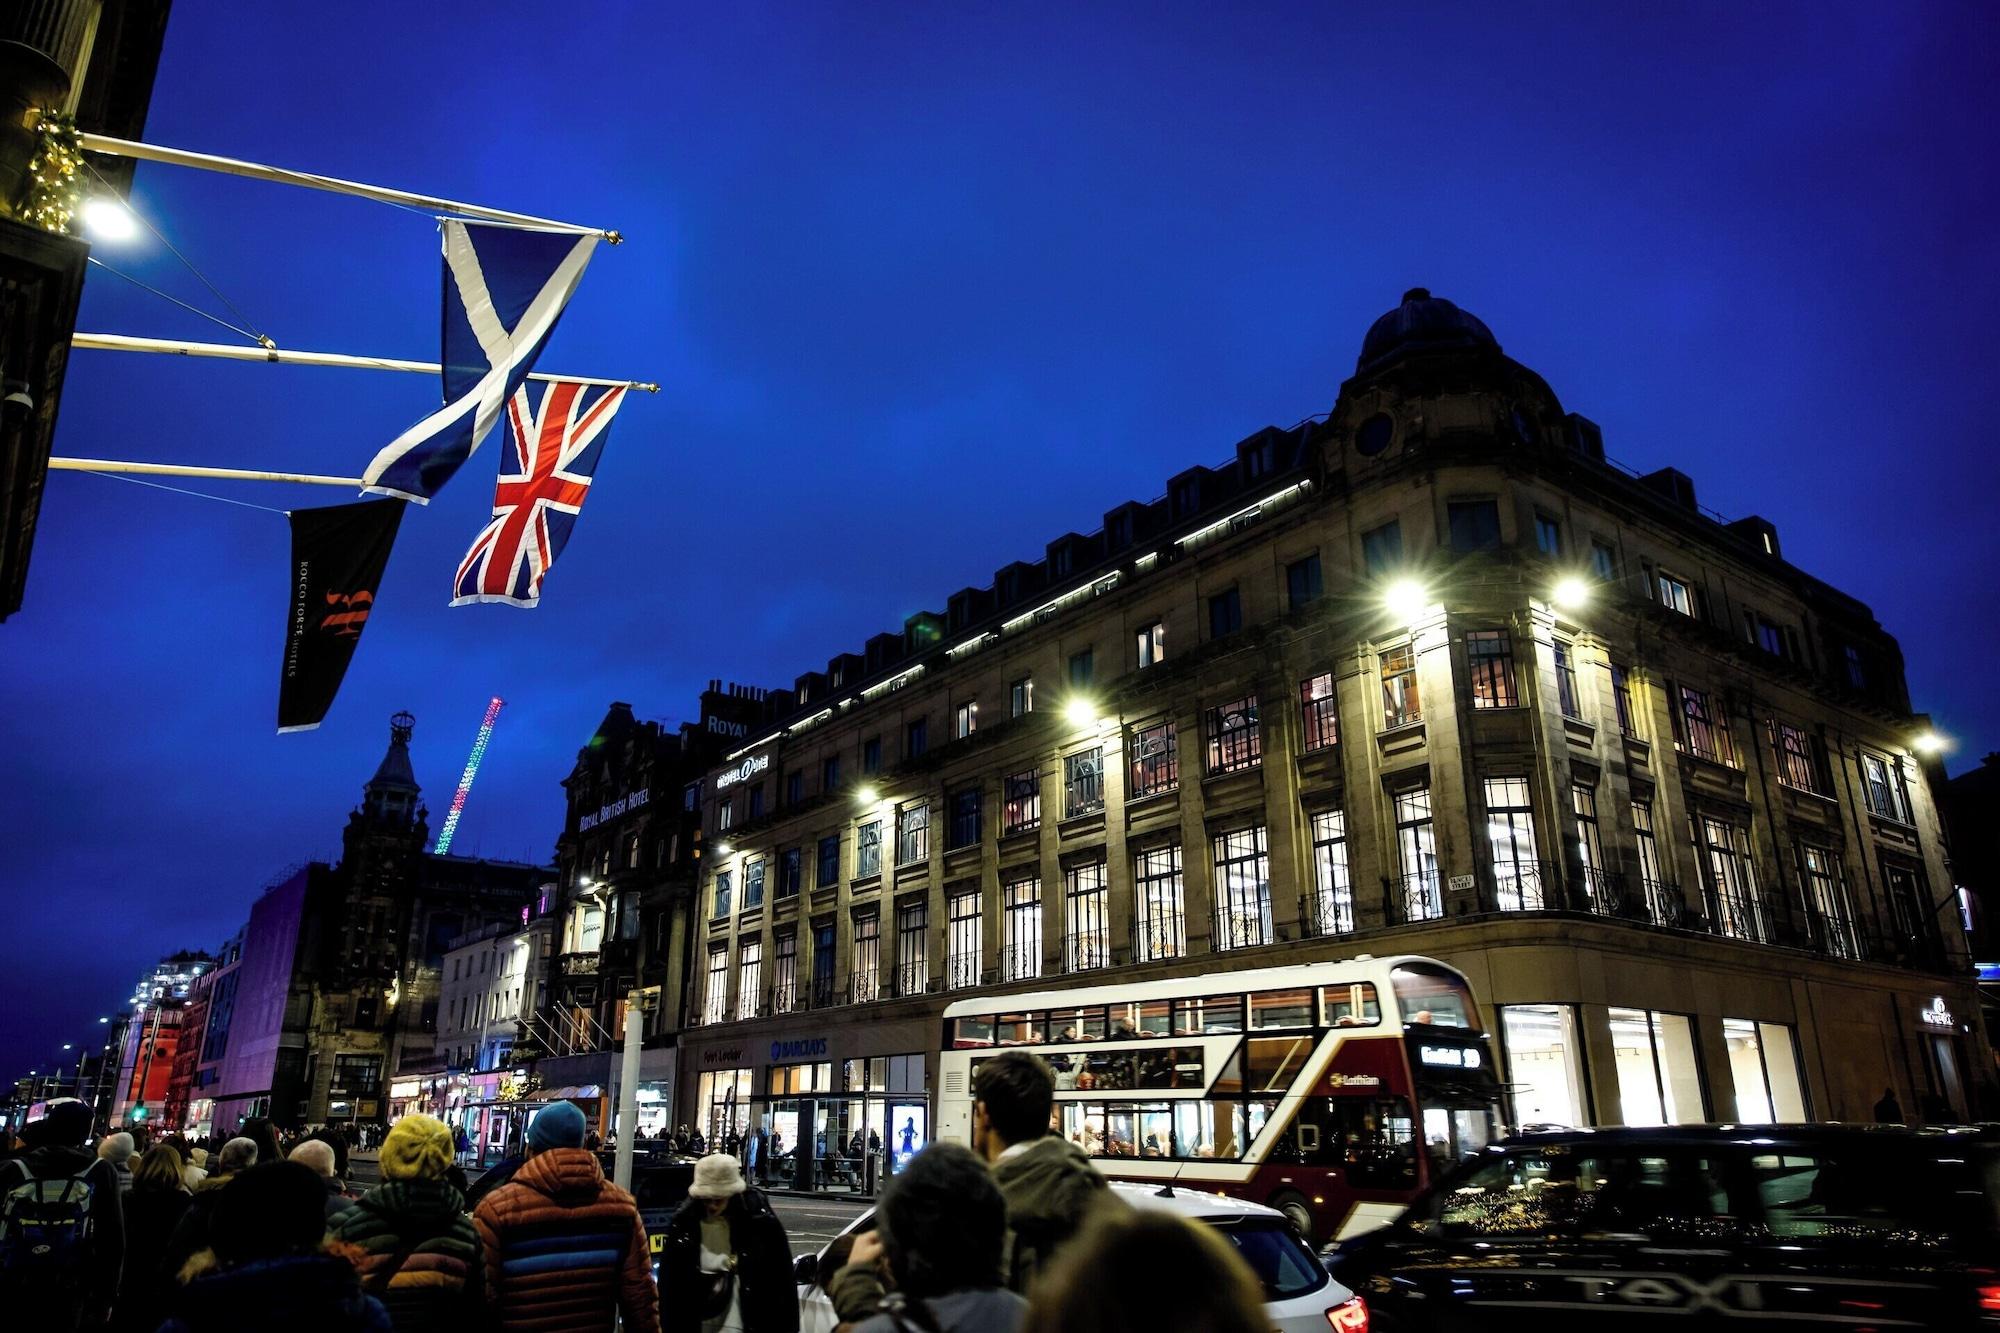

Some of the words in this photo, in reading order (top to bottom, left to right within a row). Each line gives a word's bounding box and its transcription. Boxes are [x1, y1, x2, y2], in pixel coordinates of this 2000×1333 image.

[300, 561, 309, 599] ROCCO
[580, 812, 599, 832] ROYAL
[600, 798, 626, 823] BRITISH
[628, 788, 649, 811] HOTEL
[782, 1038, 827, 1058] BARCLAYS
[1343, 1075, 1379, 1086] Lothian
[1564, 1274, 1764, 1312] TAXI
